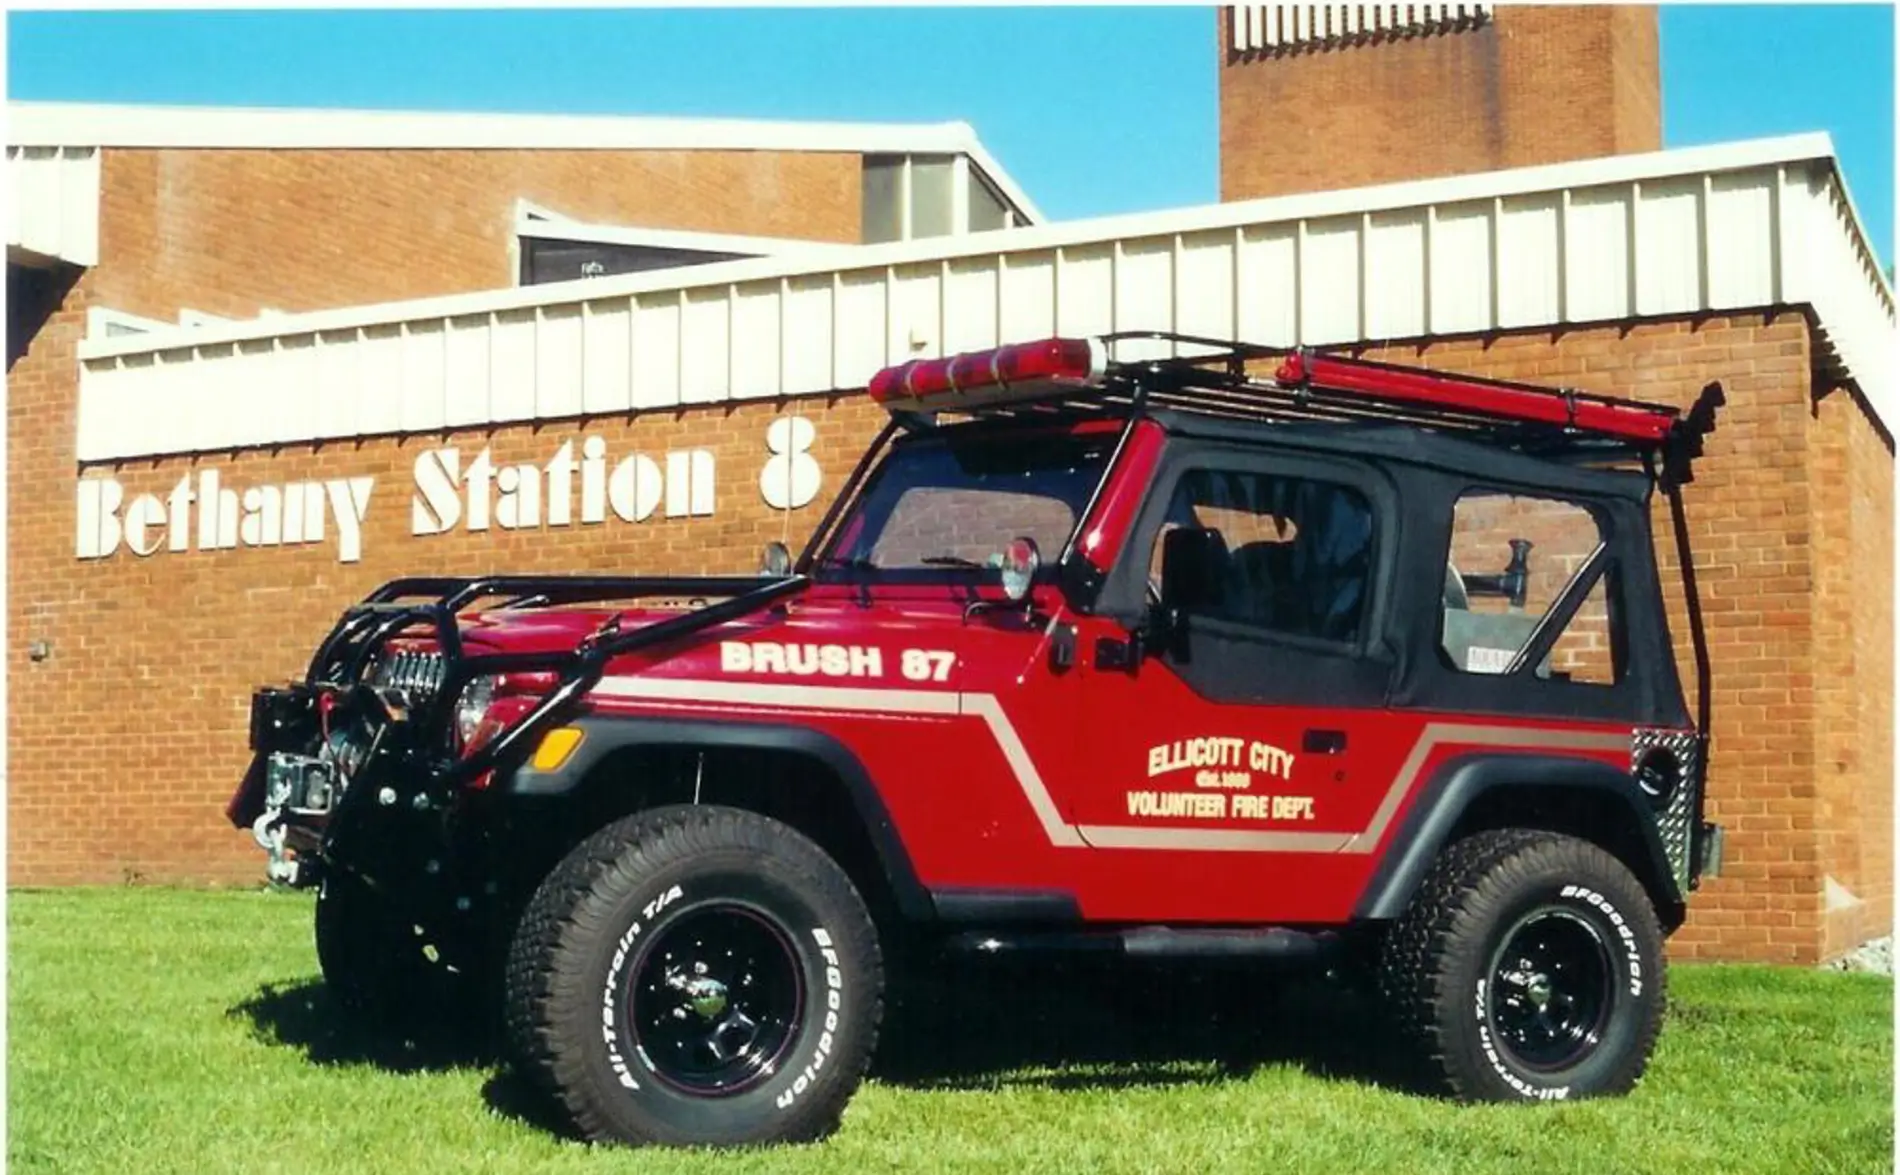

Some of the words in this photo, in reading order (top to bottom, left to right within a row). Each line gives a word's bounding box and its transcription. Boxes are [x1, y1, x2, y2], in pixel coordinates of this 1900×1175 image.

[76, 469, 374, 563] Bethany
[412, 435, 715, 536] Station
[760, 416, 822, 511] 8
[720, 641, 883, 677] BRUSH
[902, 648, 956, 681] 87
[1148, 737, 1244, 777] ELLICOTT
[1250, 741, 1294, 780] CITY
[1127, 791, 1225, 818] VOLUNTEER
[1231, 795, 1268, 819] FIRE
[1272, 796, 1315, 819] DEPT.
[642, 884, 684, 920] T/A
[1560, 885, 1643, 996] BFGoodrich
[776, 927, 842, 1109] BFGoodrich
